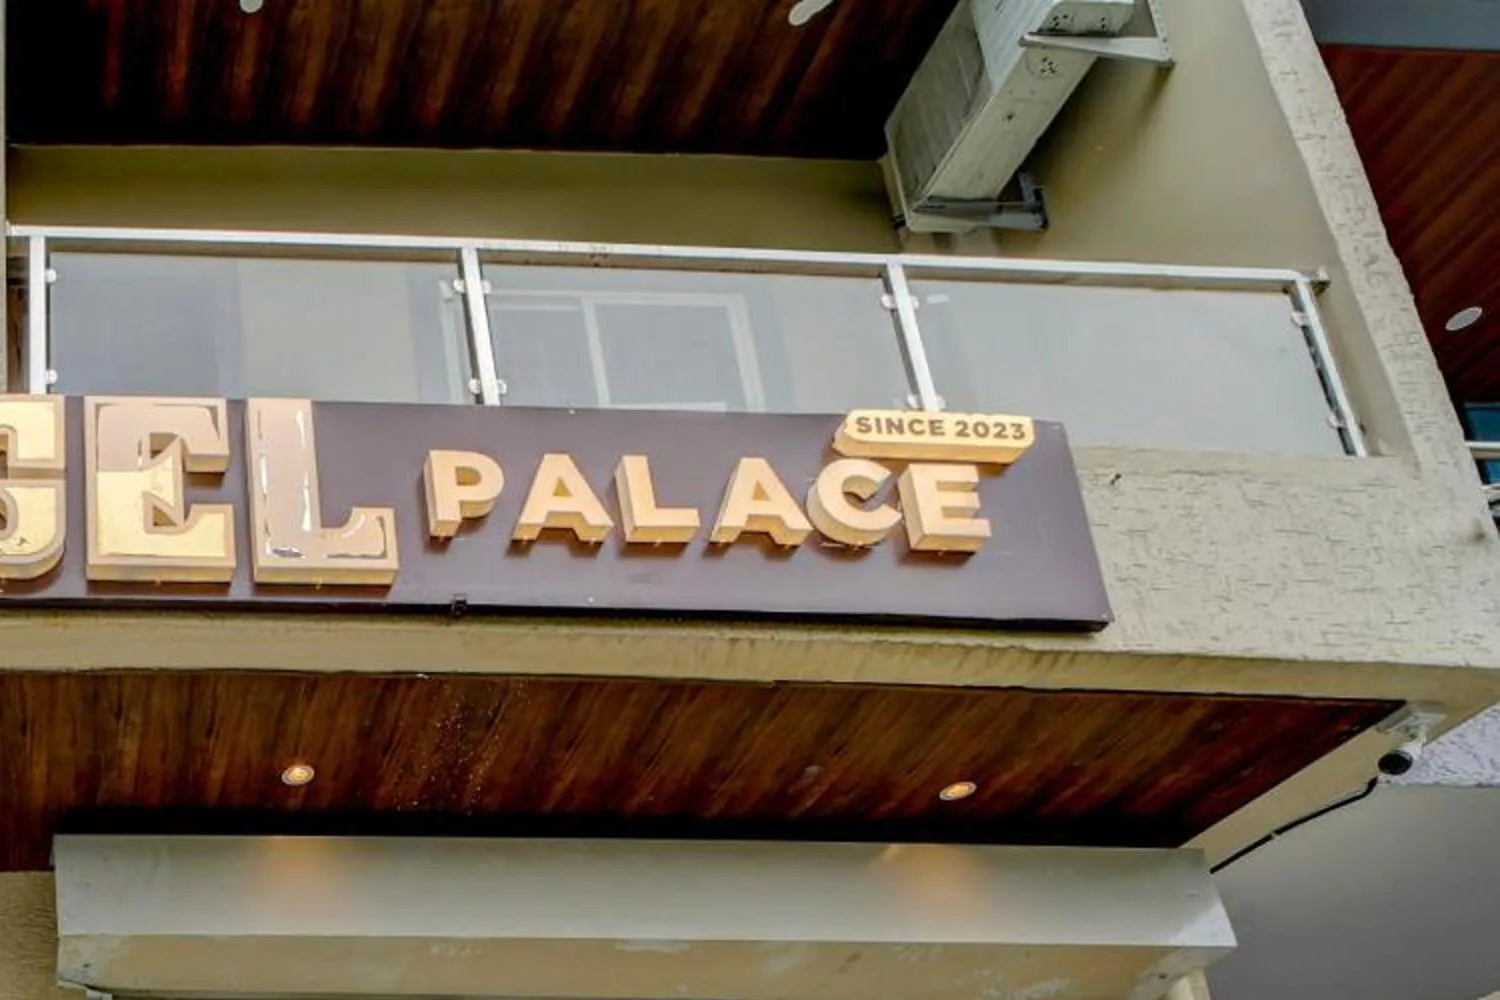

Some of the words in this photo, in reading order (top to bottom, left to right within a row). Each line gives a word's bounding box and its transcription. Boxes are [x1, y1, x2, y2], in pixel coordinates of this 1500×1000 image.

[855, 416, 946, 437] SINCE
[955, 419, 1026, 441] 2023
[423, 449, 990, 552] PALACE
